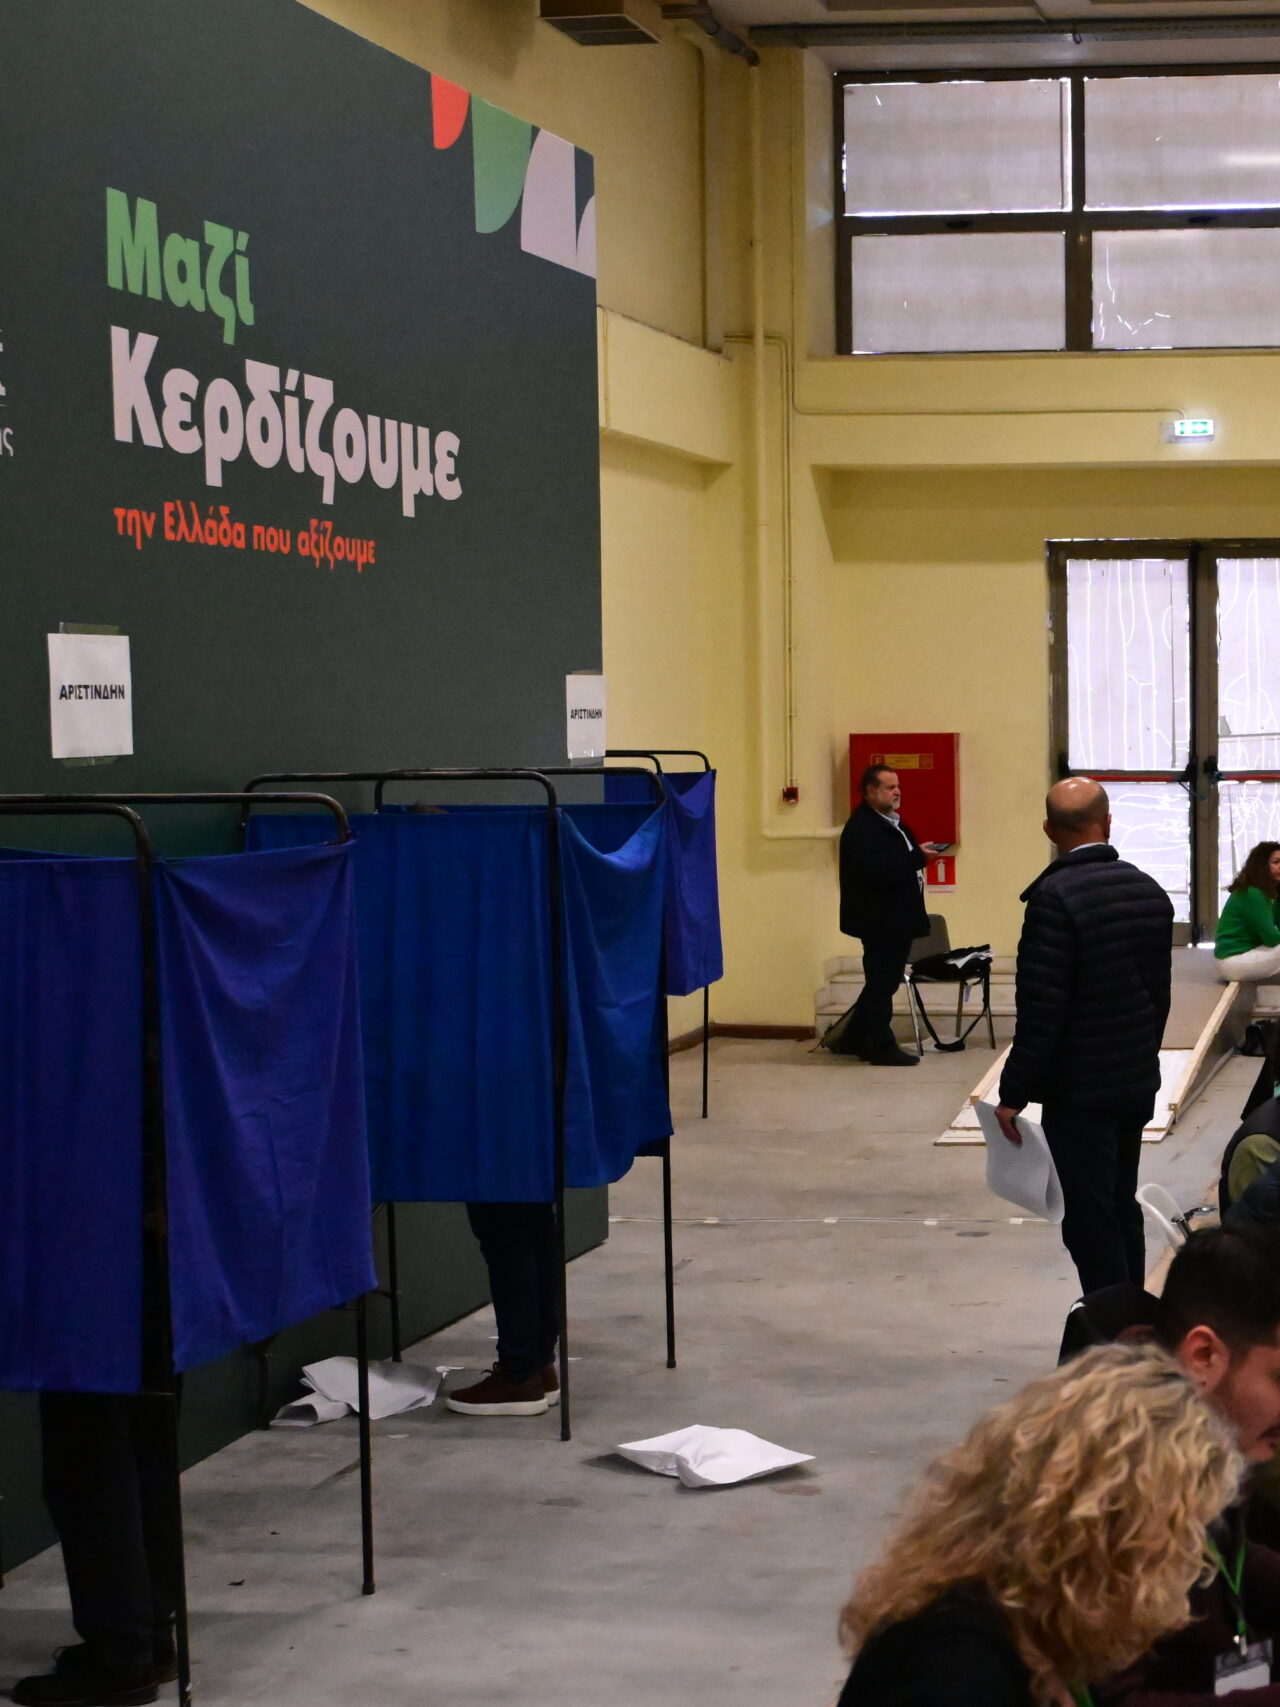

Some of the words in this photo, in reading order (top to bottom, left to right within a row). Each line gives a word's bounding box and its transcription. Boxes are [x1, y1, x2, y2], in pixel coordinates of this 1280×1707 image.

[106, 187, 254, 345] Μαζί
[110, 325, 463, 517] Κερδίζουμε
[113, 507, 157, 550] την
[163, 500, 246, 549] Ελλάδα
[252, 525, 291, 554] που
[297, 518, 376, 574] αξίζουμε
[59, 684, 125, 700] ΑΡΙΣΤΙΝΔΗΝ
